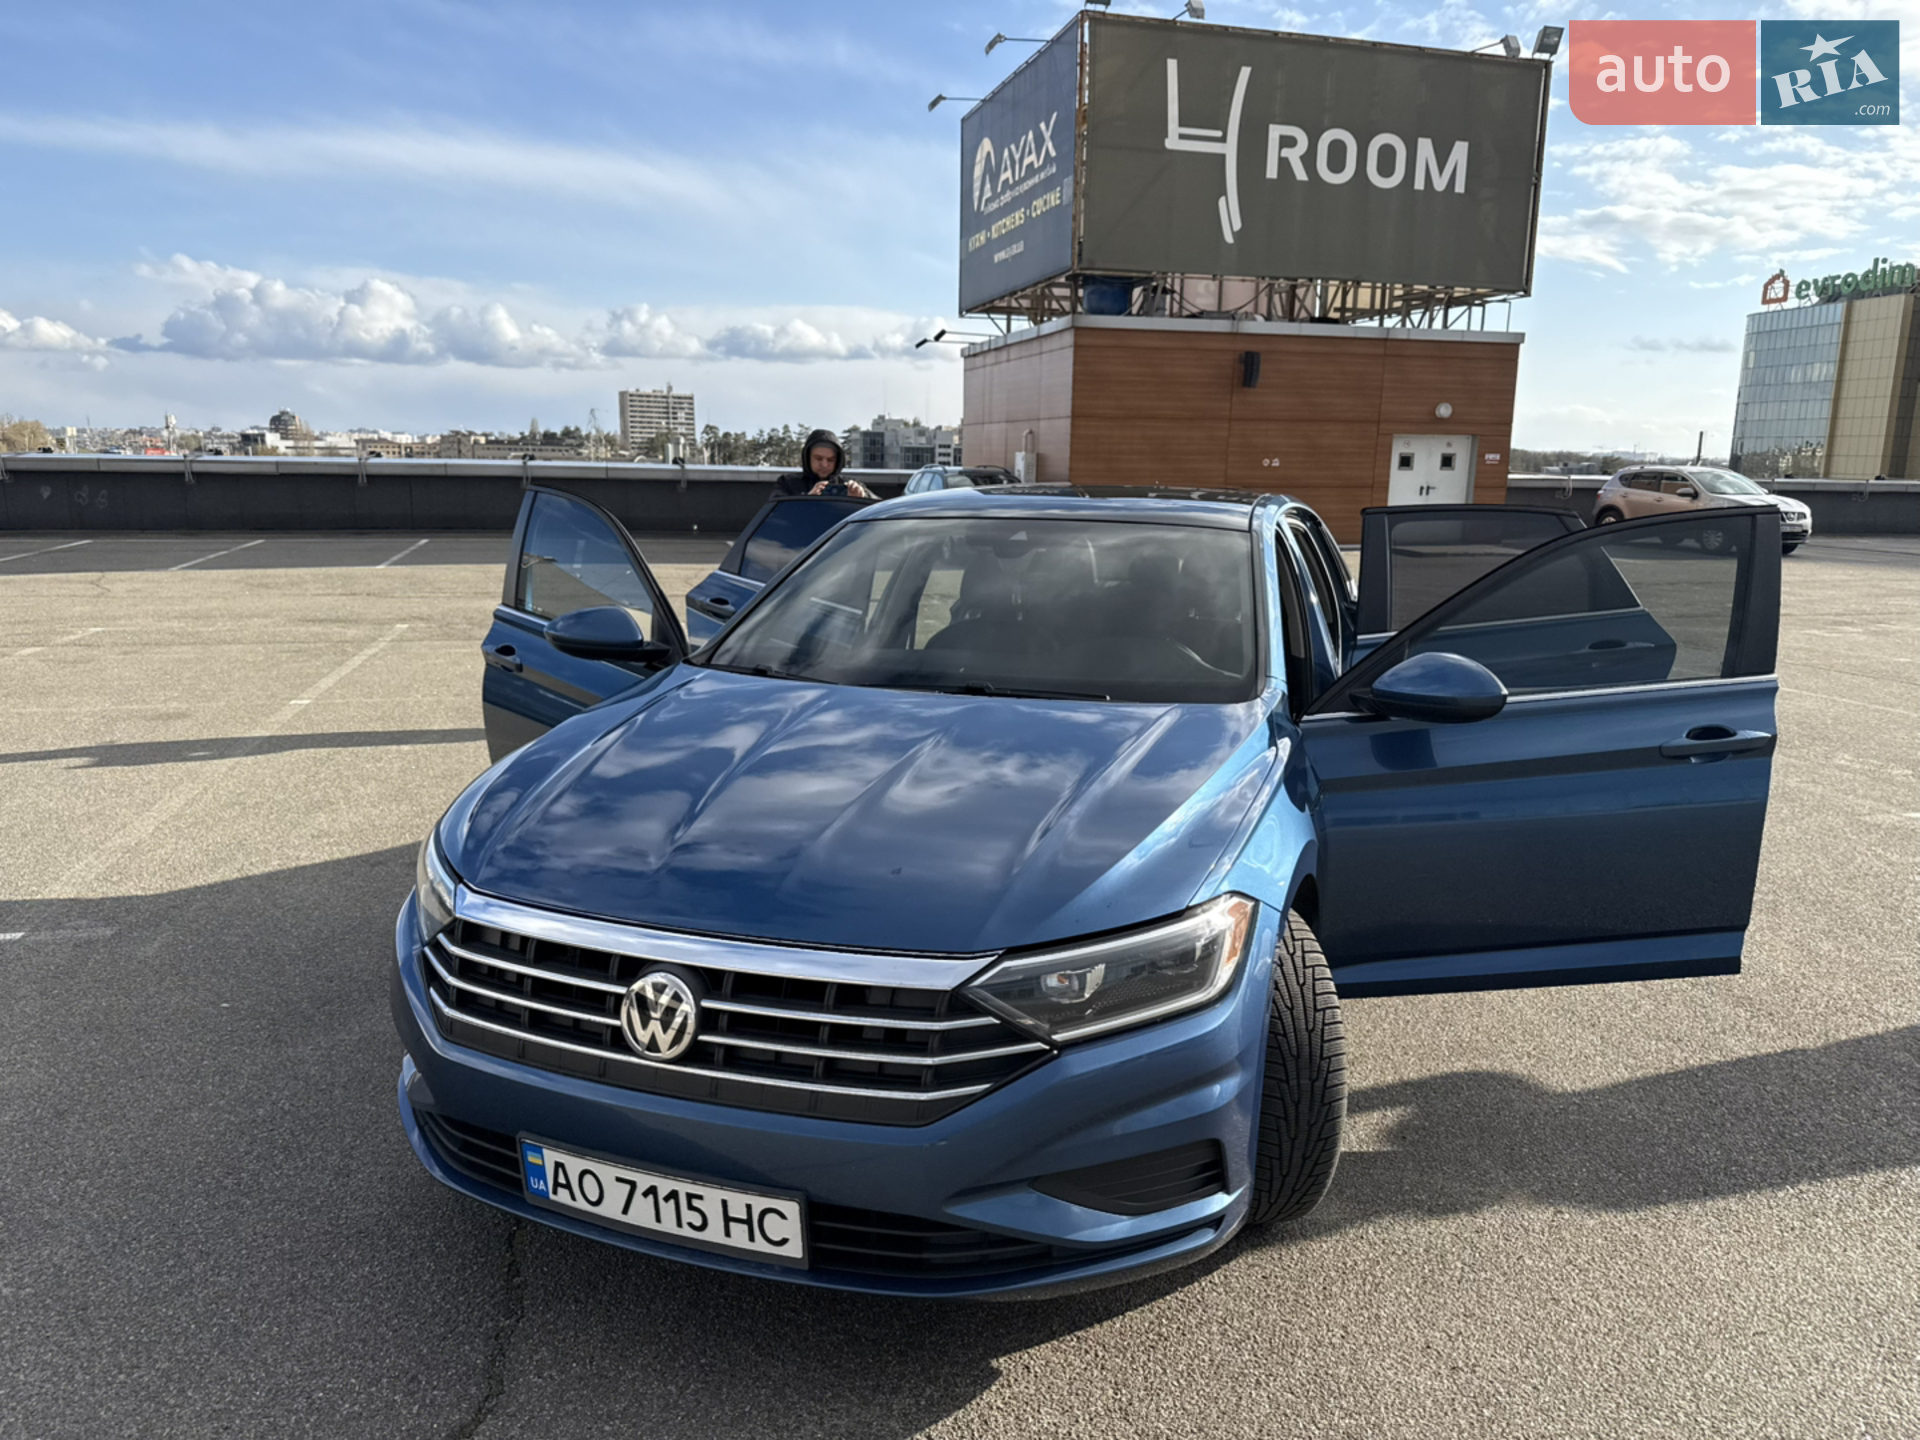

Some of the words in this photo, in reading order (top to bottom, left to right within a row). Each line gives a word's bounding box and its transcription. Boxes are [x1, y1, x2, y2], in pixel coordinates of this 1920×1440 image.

[997, 111, 1058, 193] AYAX
[1265, 123, 1470, 194] ROOM
[1030, 187, 1061, 218] CUCINE
[1795, 257, 1917, 300] evrodim
[530, 1176, 547, 1193] UA
[551, 1160, 605, 1208] AO
[614, 1175, 709, 1233] 7115
[721, 1198, 791, 1248] HC
